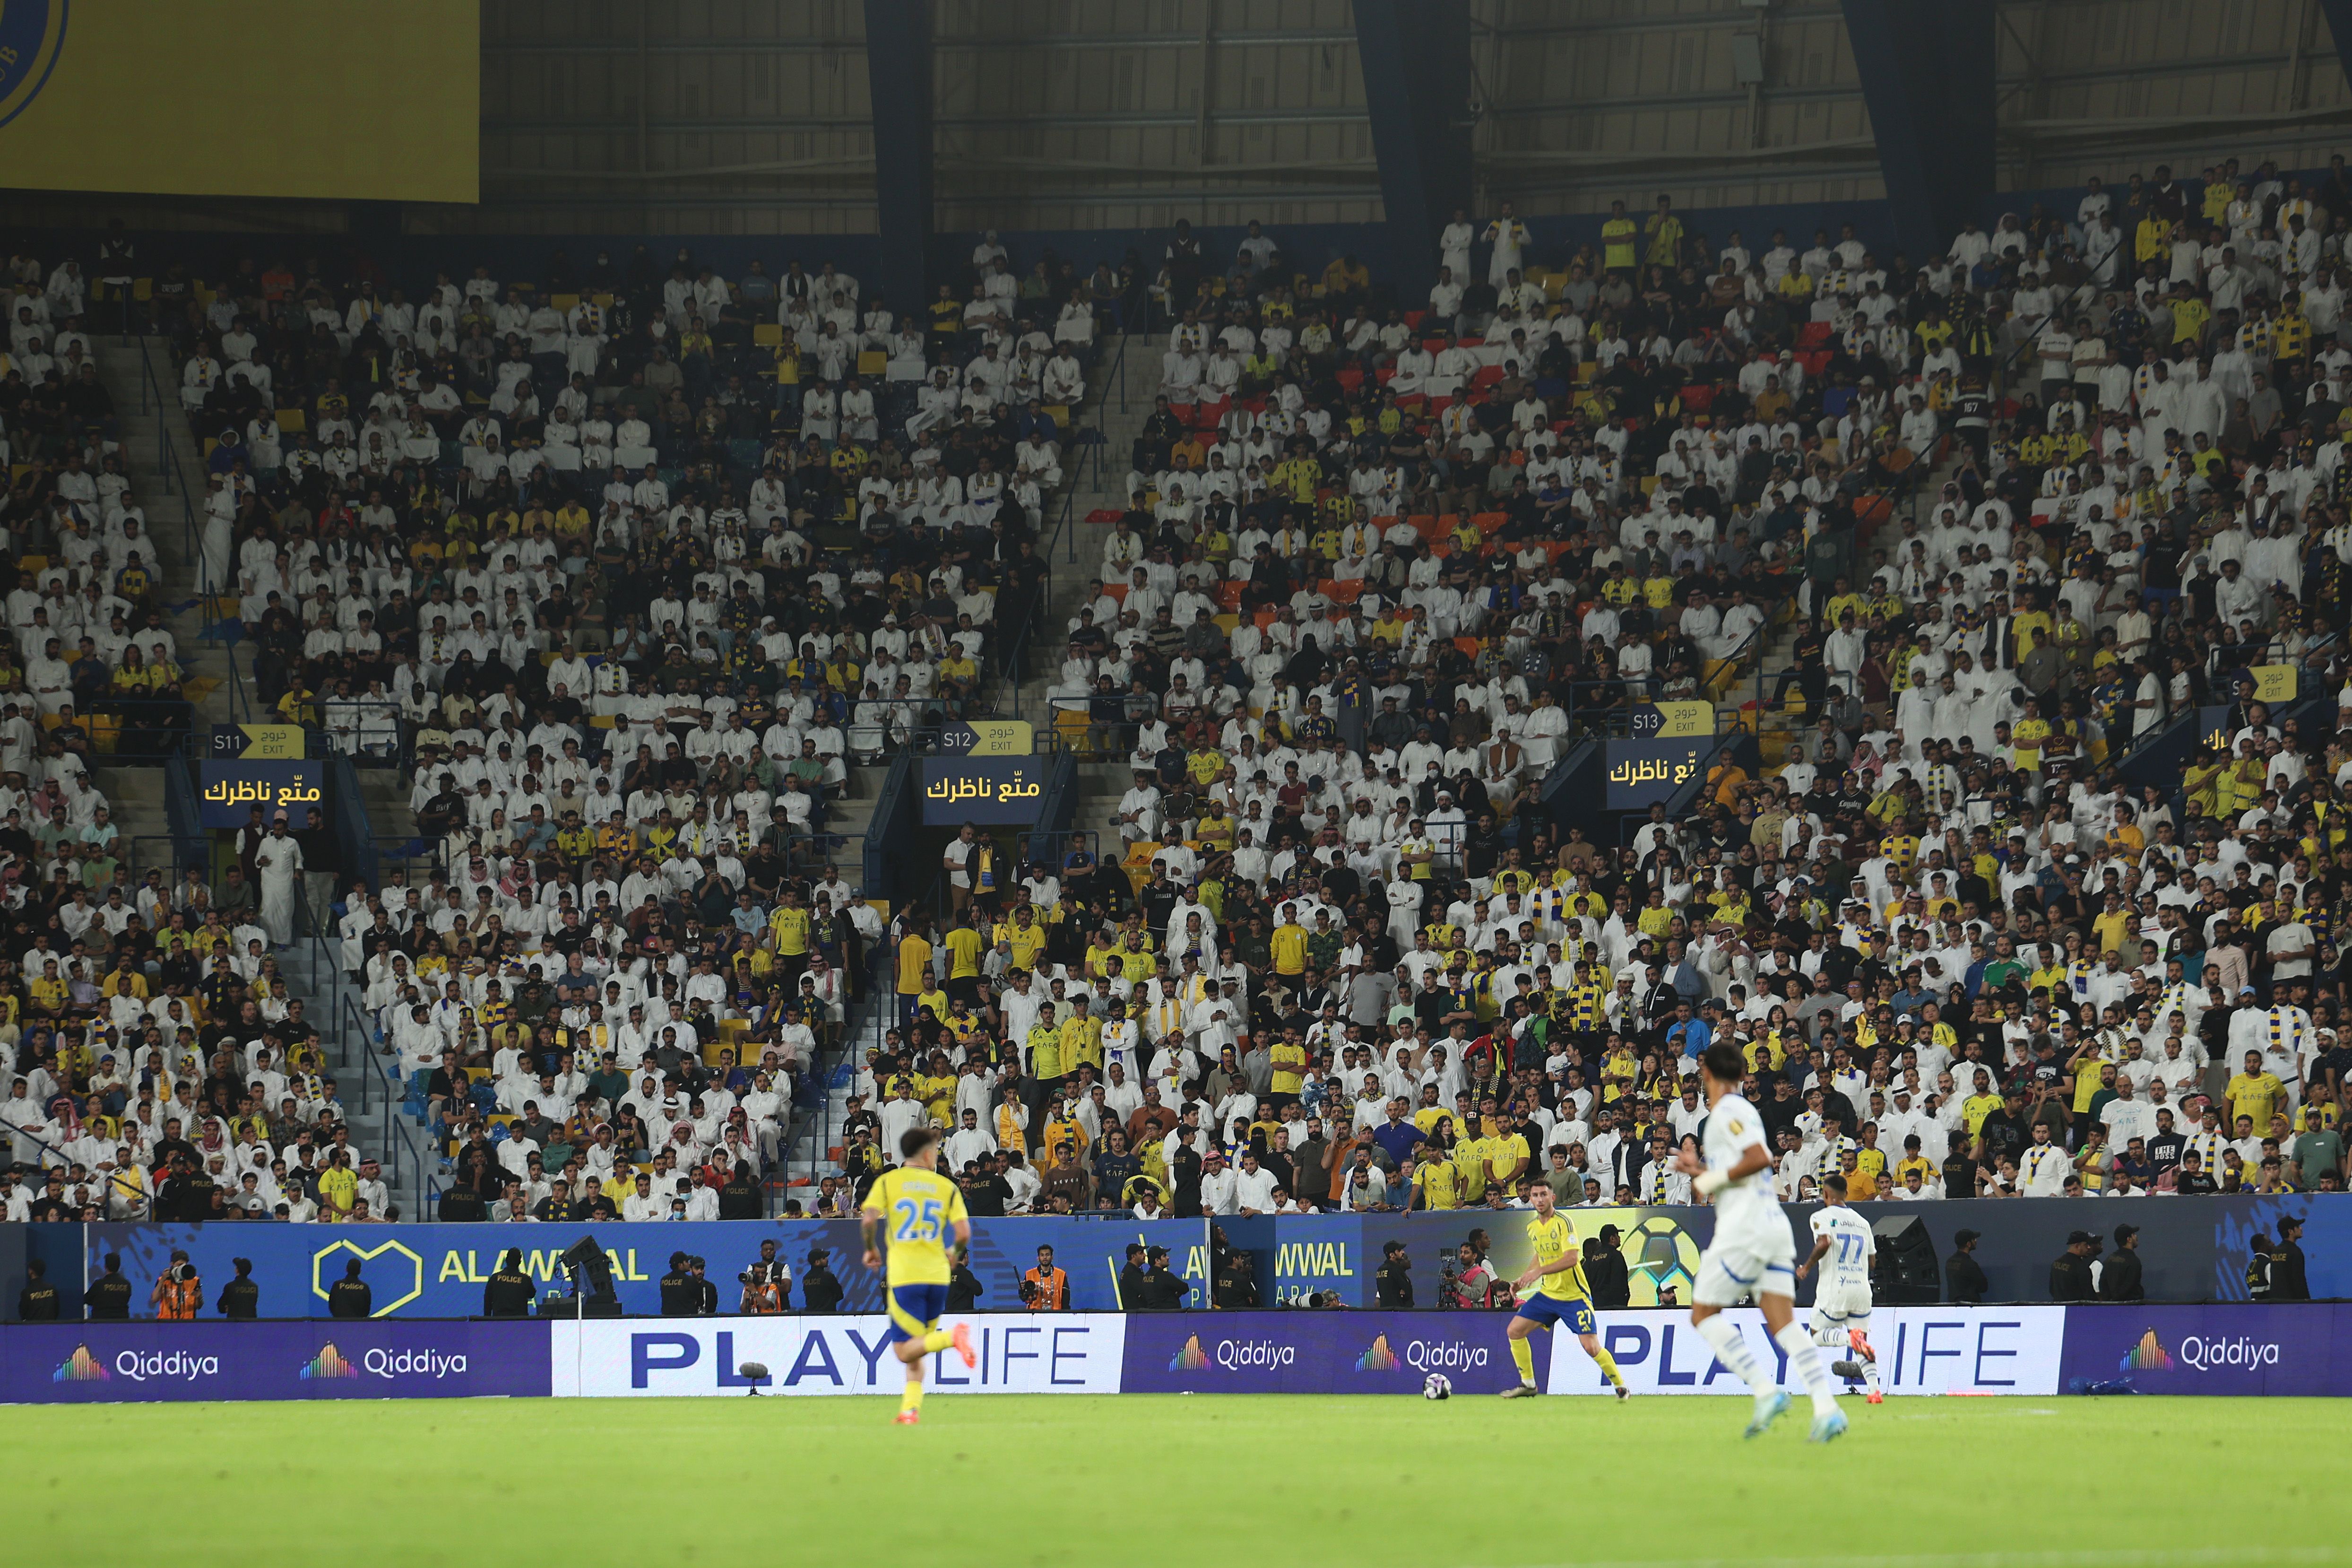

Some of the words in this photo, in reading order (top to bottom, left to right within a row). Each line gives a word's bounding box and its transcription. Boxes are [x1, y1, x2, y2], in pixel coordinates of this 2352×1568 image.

[2266, 687, 2282, 697] EXIT
[1674, 707, 1697, 719] خروج
[1634, 714, 1658, 729] S13
[1676, 722, 1695, 731] EXIT
[261, 730, 286, 742] خروج
[989, 727, 1014, 738] خروج
[215, 736, 240, 749] S11
[944, 733, 970, 746] S12
[263, 745, 285, 754] EXIT
[991, 742, 1012, 750] EXIT
[1610, 758, 1668, 787] ناظرك
[204, 780, 270, 806] ناظرك
[927, 777, 991, 803] ناظرك
[1838, 799, 1862, 809] Loyalty
[1073, 1031, 1094, 1039] KFD
[2155, 1145, 2176, 1153] THE
[971, 1180, 990, 1190] POLICE
[450, 1193, 476, 1201] POLICE
[894, 1198, 944, 1241] 25
[1836, 1232, 1864, 1263] 77
[1591, 1253, 1608, 1262] Police
[497, 1275, 522, 1283] POLICE
[1376, 1270, 1388, 1278] OLICE
[104, 1283, 129, 1292] POLICE
[30, 1289, 54, 1300] POLICE
[1576, 1309, 1591, 1326] 27
[1217, 1340, 1295, 1371] Qiddiya
[1407, 1340, 1488, 1371] Qiddiya
[2181, 1336, 2279, 1371] Qiddiya
[116, 1351, 218, 1382] Qiddiya
[364, 1348, 467, 1379] Qiddiya
